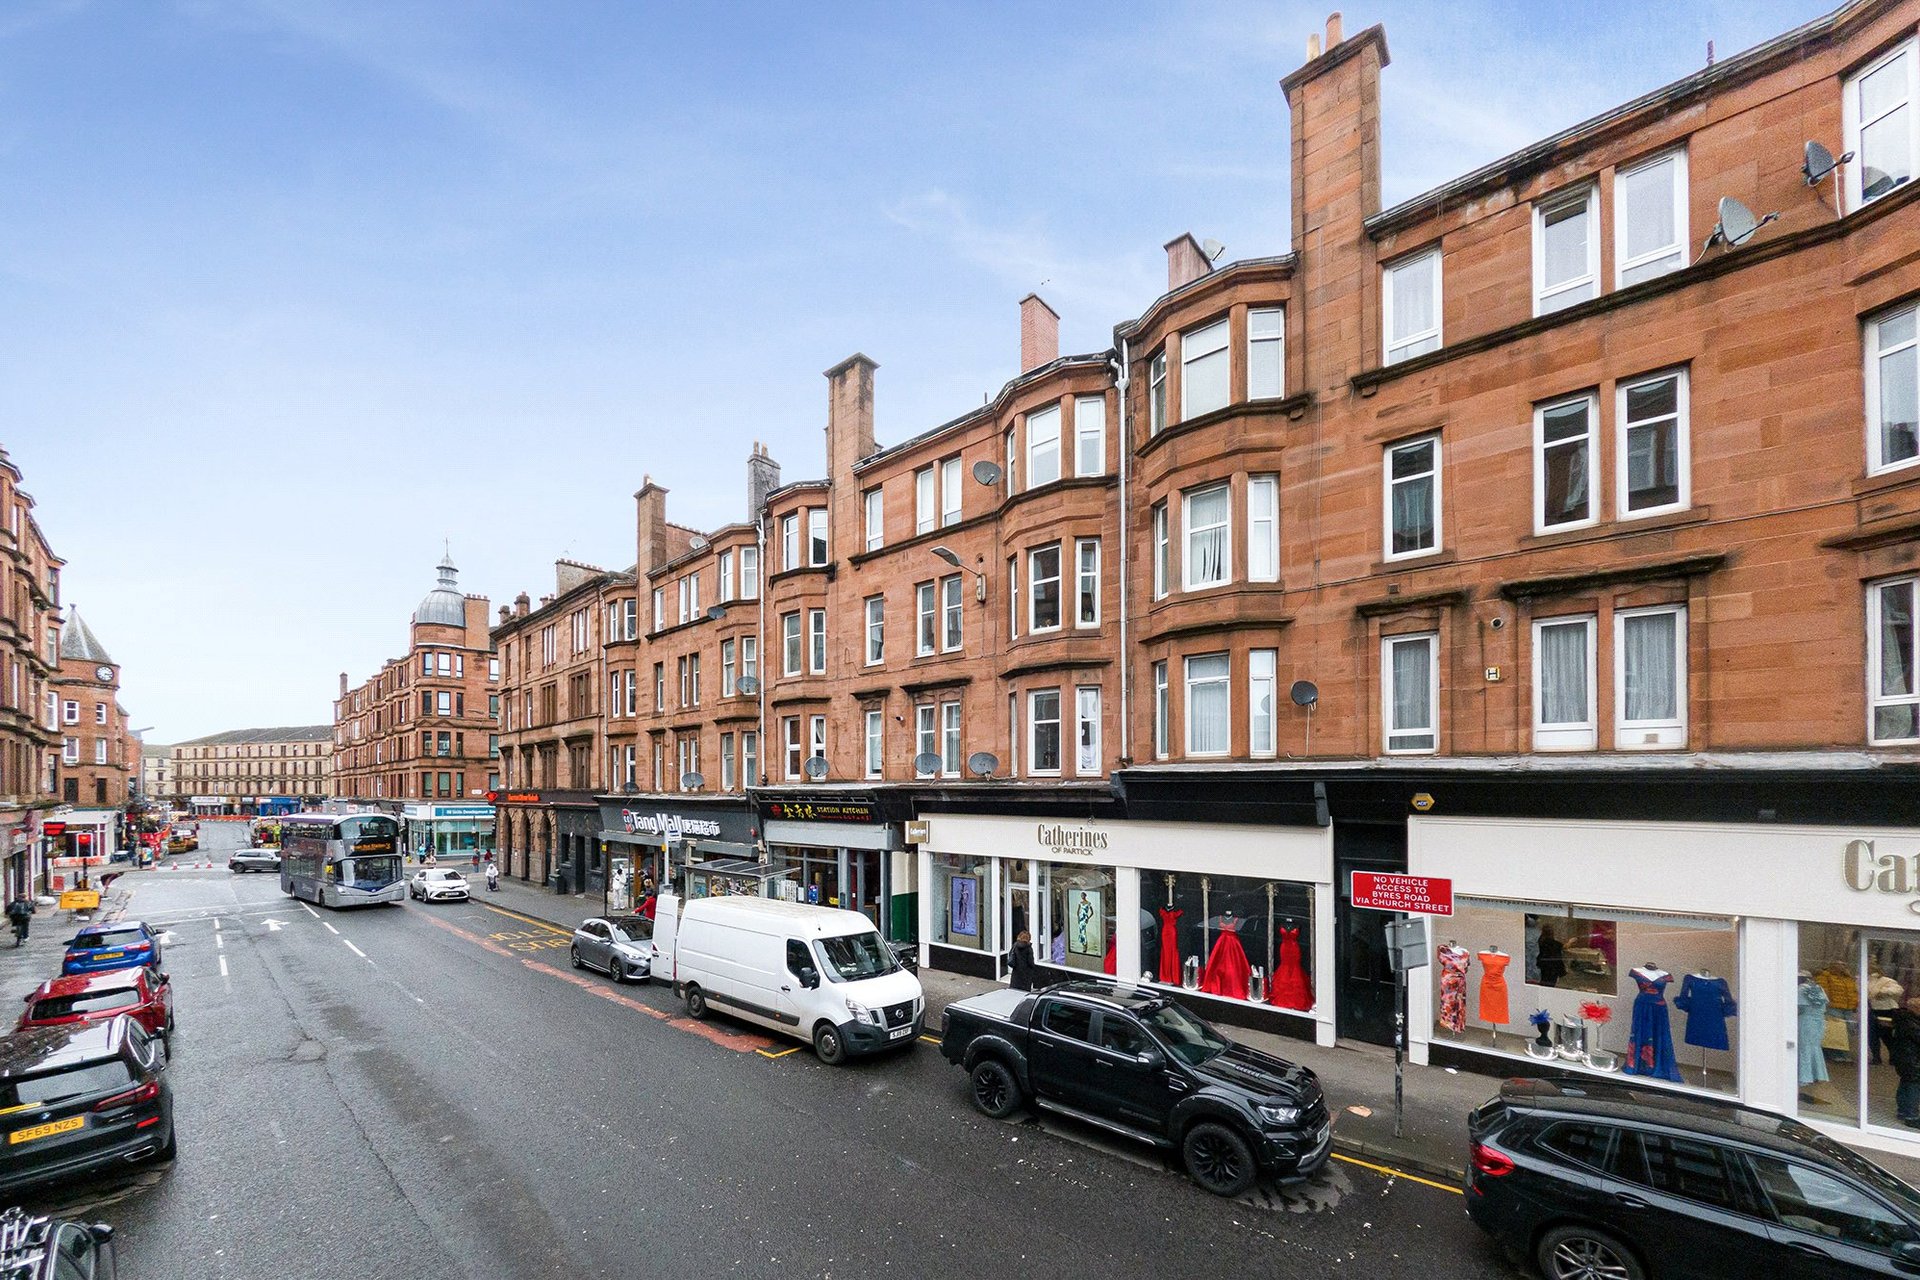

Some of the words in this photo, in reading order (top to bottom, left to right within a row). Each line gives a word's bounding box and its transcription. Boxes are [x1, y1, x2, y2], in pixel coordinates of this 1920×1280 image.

[842, 806, 869, 814] KITCHEN
[631, 811, 659, 835] Tang
[656, 813, 683, 833] Mall
[1037, 823, 1108, 850] Catherines
[1051, 846, 1062, 854] OF
[1063, 847, 1094, 857] PARTICK
[1389, 877, 1429, 887] VEHICLE
[1375, 884, 1412, 893] ACCESS
[1414, 886, 1427, 894] TO
[1372, 890, 1402, 900] BYRES
[1404, 893, 1431, 902] ROAD
[1355, 896, 1370, 904] VIA
[1372, 898, 1411, 908] CHURCH
[1414, 902, 1450, 912] STREET
[18, 1125, 51, 1141] SF69
[54, 1119, 78, 1131] NZS
